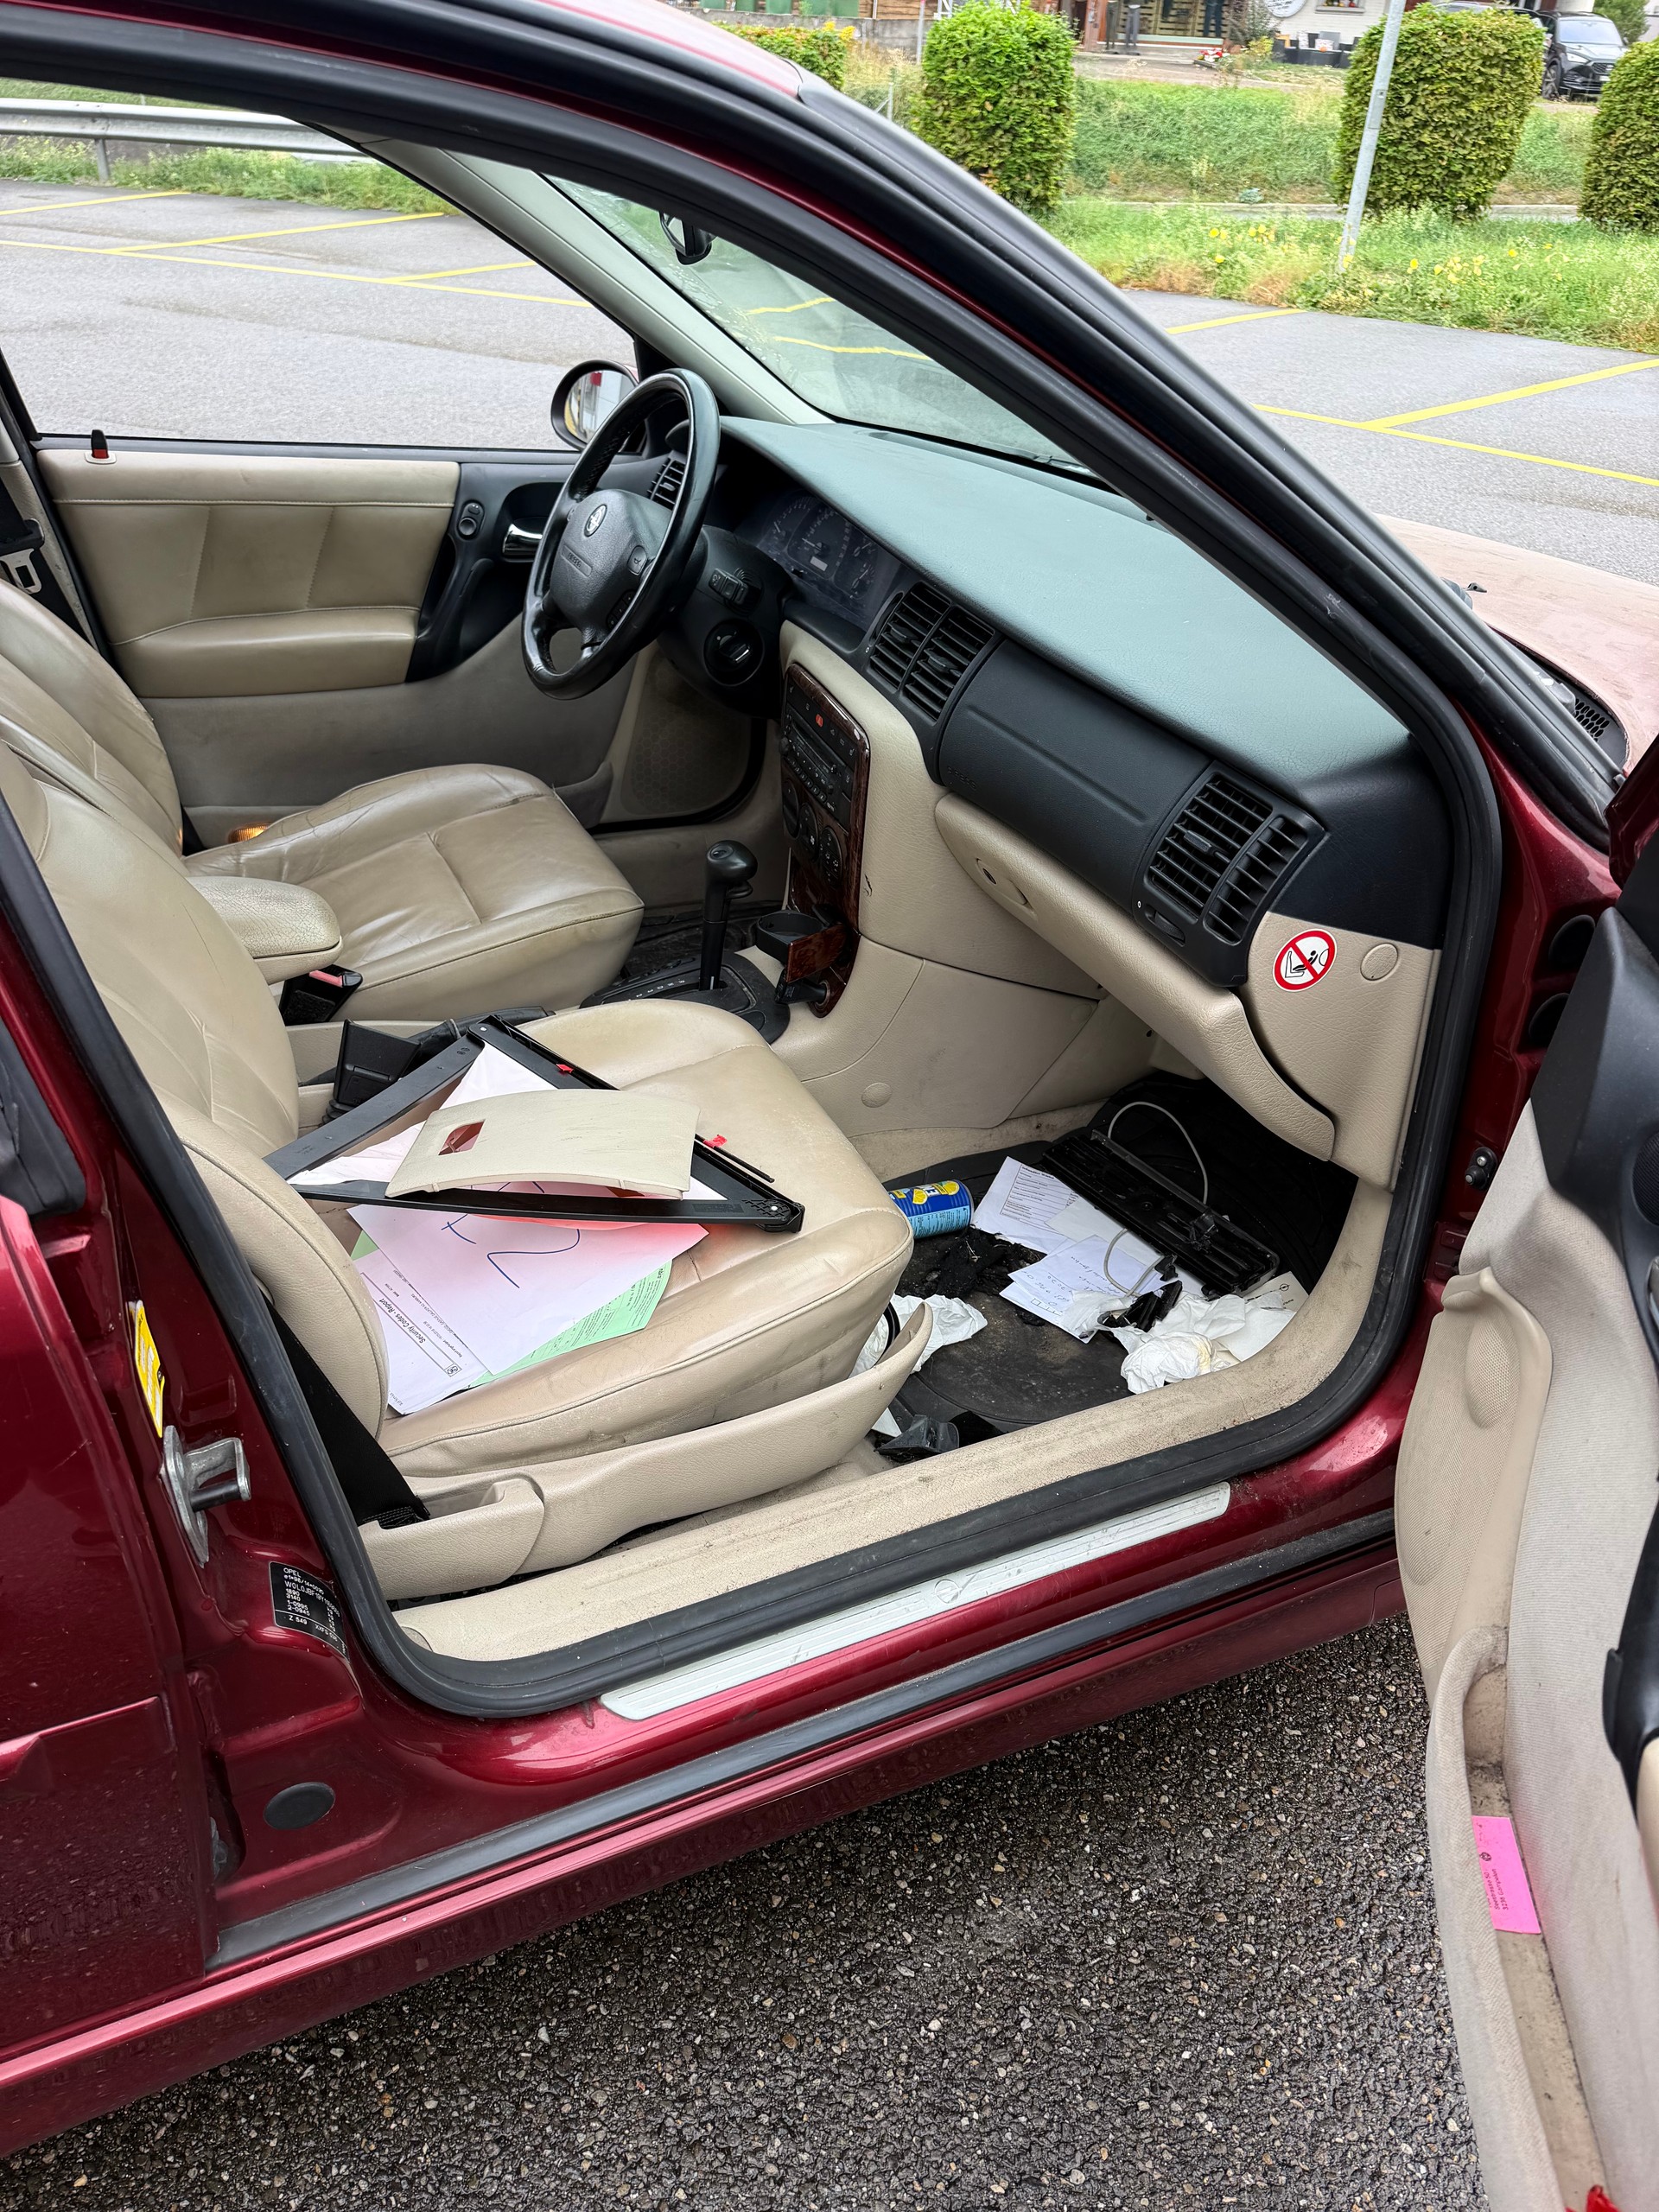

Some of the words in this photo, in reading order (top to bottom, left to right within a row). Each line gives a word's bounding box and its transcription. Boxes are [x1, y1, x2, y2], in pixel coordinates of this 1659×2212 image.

[378, 1298, 395, 1313] Report
[395, 1313, 410, 1328] Codes
[409, 1325, 426, 1344] Security
[283, 1567, 301, 1578] OPEL
